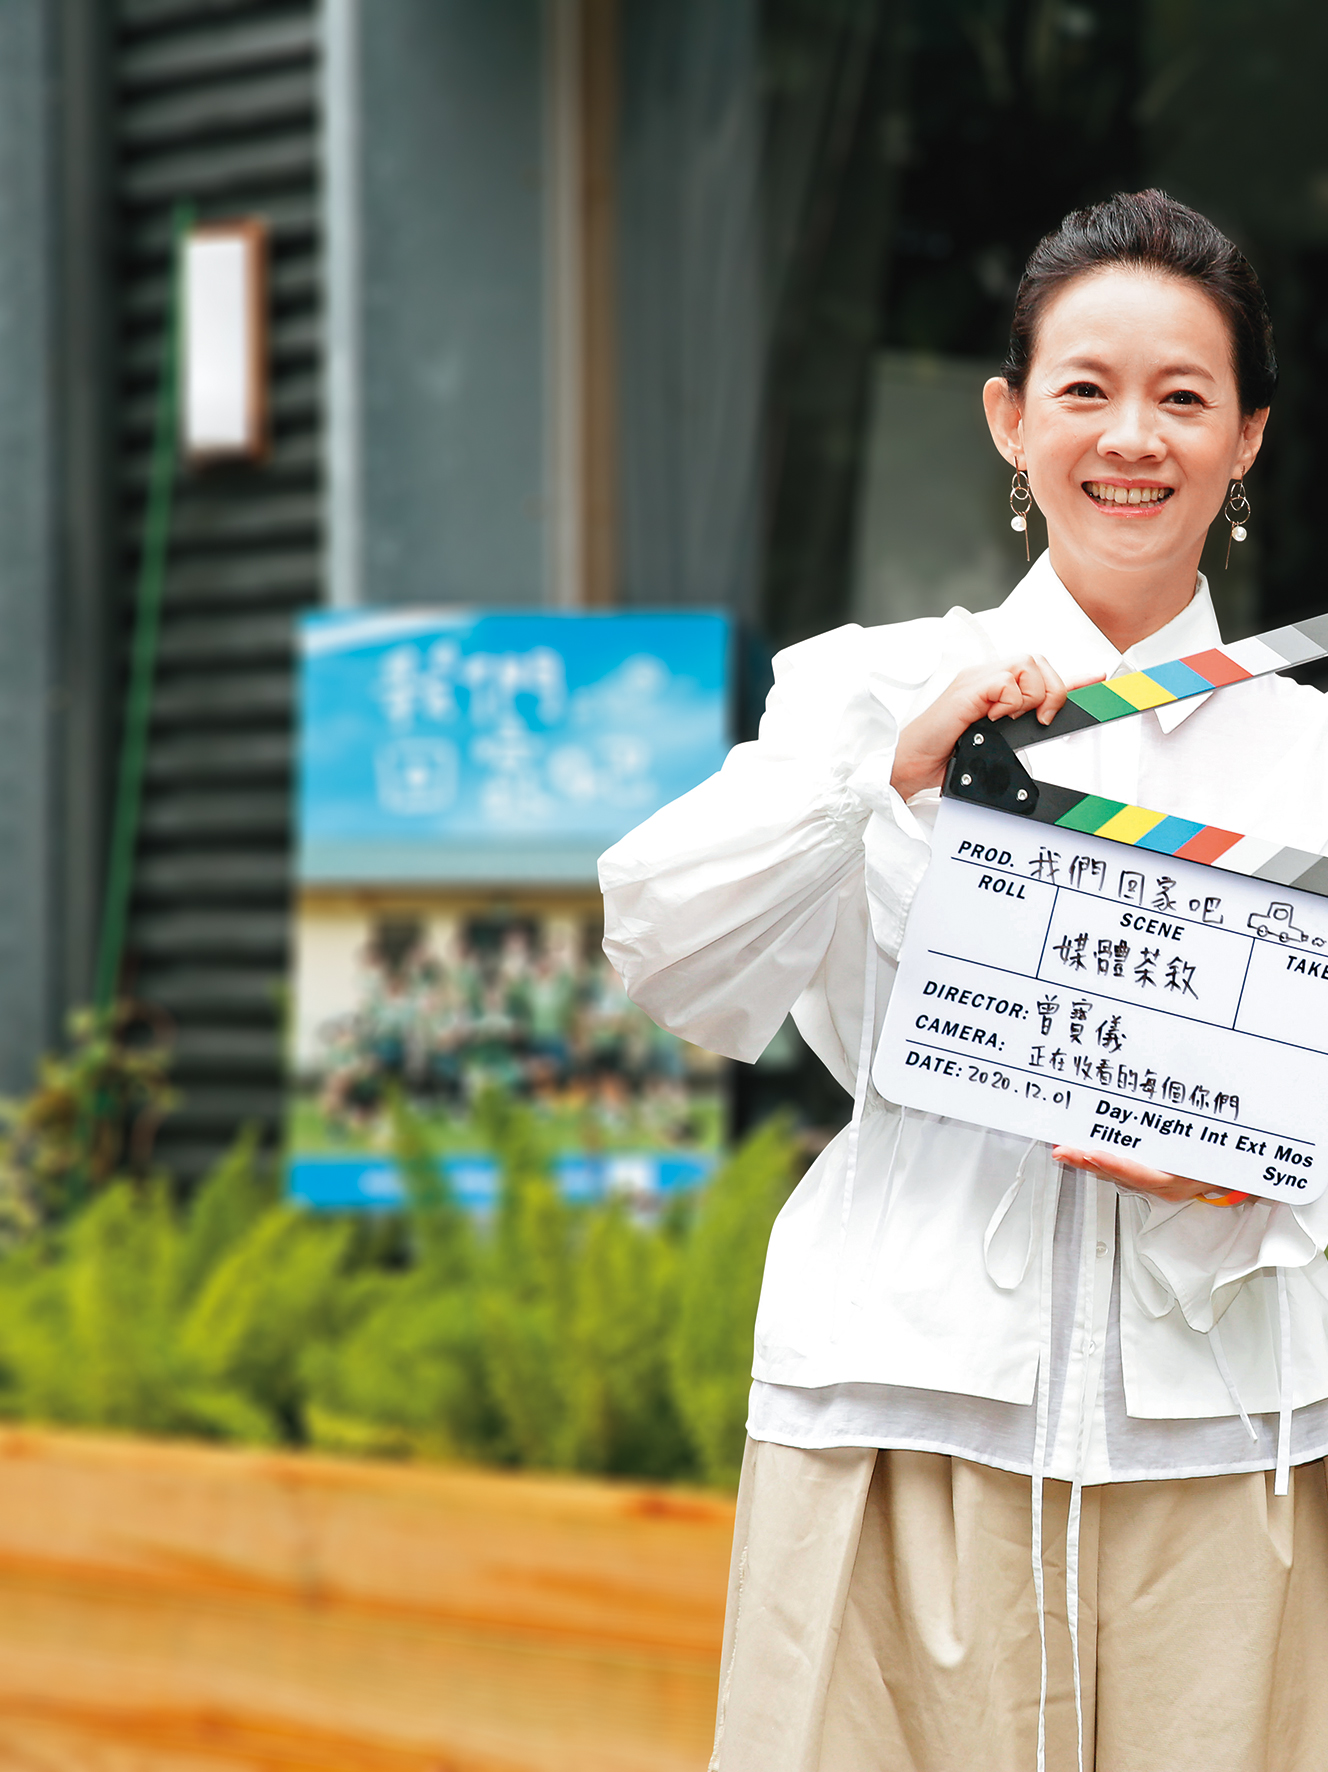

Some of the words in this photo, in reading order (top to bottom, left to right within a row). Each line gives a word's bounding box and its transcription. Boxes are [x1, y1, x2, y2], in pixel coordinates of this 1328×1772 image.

[957, 840, 1015, 867] PROD.
[978, 874, 1027, 900] ROLL
[1028, 846, 1225, 925] 我們回家吧
[1119, 913, 1185, 942] SCENE
[923, 981, 1030, 1021] DIRECTOR:
[914, 1015, 1006, 1052] CAMERA:
[1036, 994, 1127, 1053] 曾寶儀
[905, 1051, 963, 1079] DATE:
[1028, 1045, 1240, 1120] 正在收看的每個你們
[967, 1065, 1072, 1109] 2020.12.01
[1090, 1124, 1142, 1150] Filter
[1200, 1126, 1228, 1148] Int
[1235, 1136, 1267, 1157] Ext
[1273, 1146, 1314, 1169] Mos
[1262, 1167, 1309, 1191] Sync
